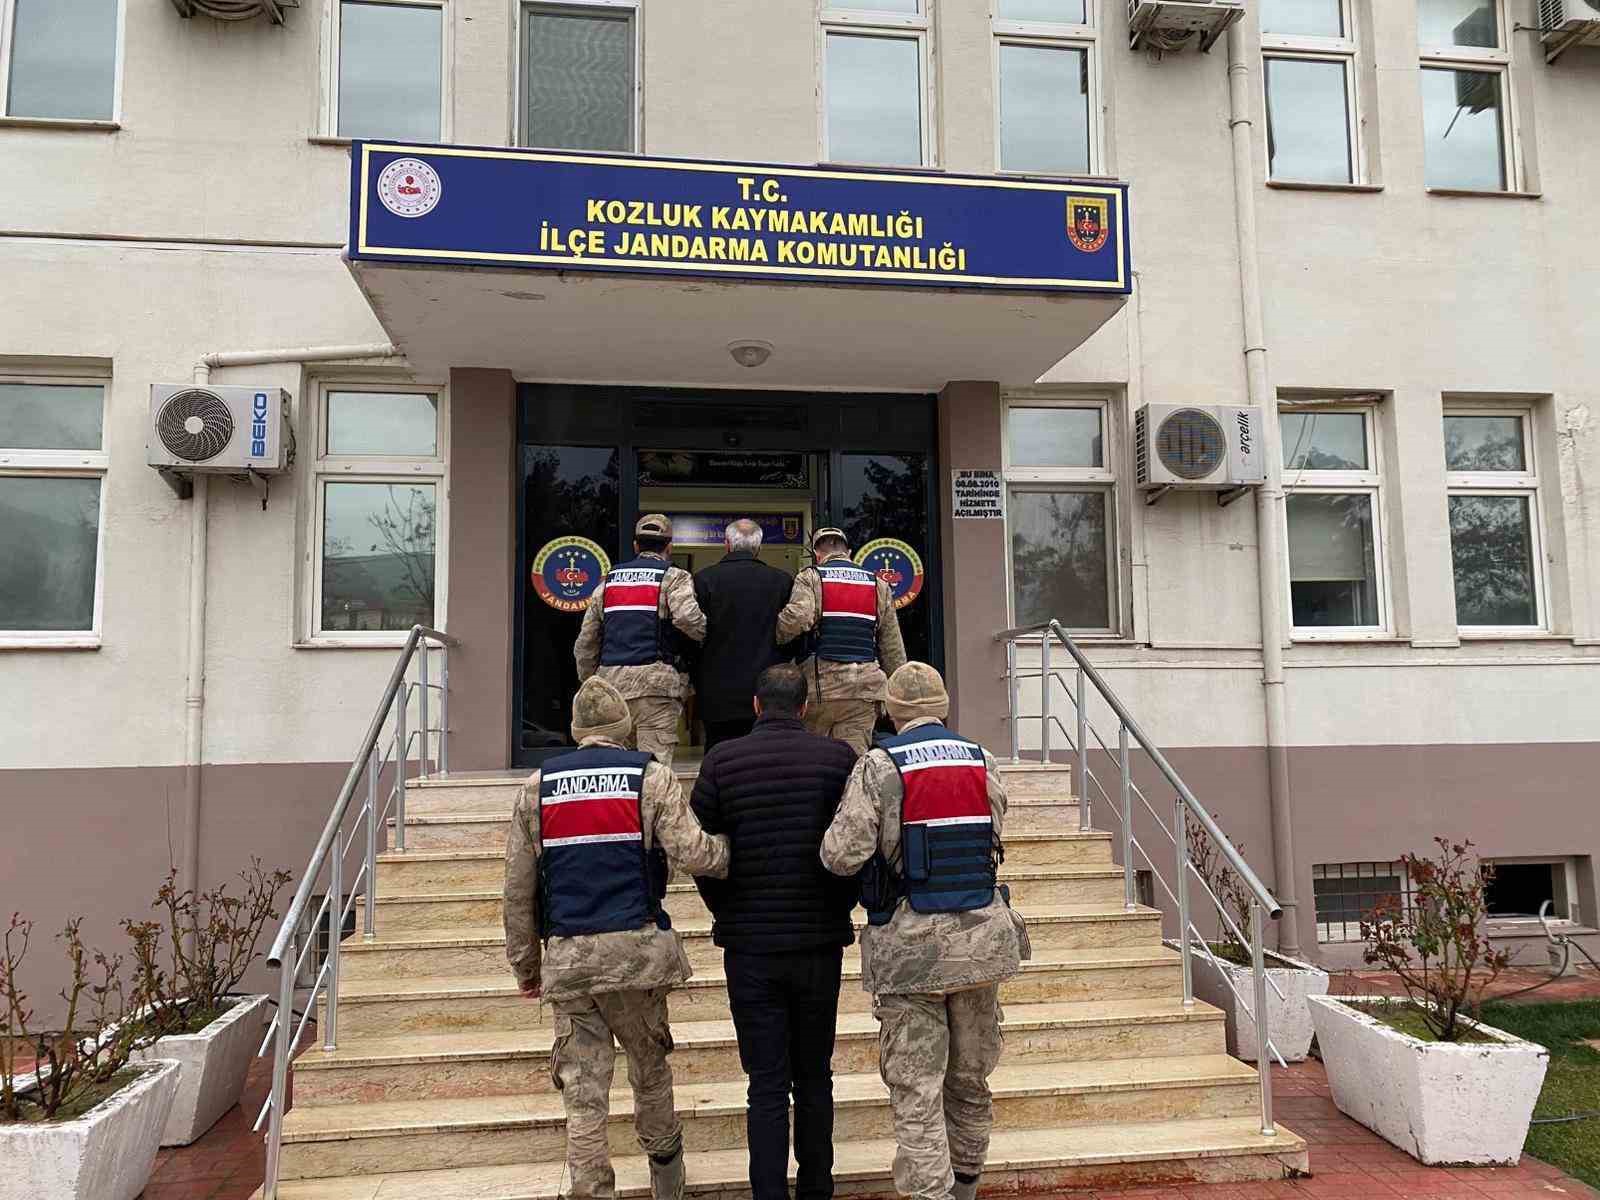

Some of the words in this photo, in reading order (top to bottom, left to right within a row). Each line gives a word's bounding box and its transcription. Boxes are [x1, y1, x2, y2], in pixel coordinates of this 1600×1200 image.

[737, 177, 788, 202] T.C.
[586, 199, 703, 228] KOZLUK
[711, 206, 924, 239] KAYMAKAMLIĞI
[539, 221, 606, 258] İLÇE
[613, 232, 769, 262] JANDARMA
[777, 239, 967, 271] KOMUTANLIĞI
[251, 393, 268, 457] BEKO
[611, 571, 657, 583] JANDARMA
[825, 569, 870, 581] JANDARMA
[542, 592, 593, 610] JANDAR
[904, 744, 974, 764] JANDARMA
[551, 774, 630, 796] JANDARMA
